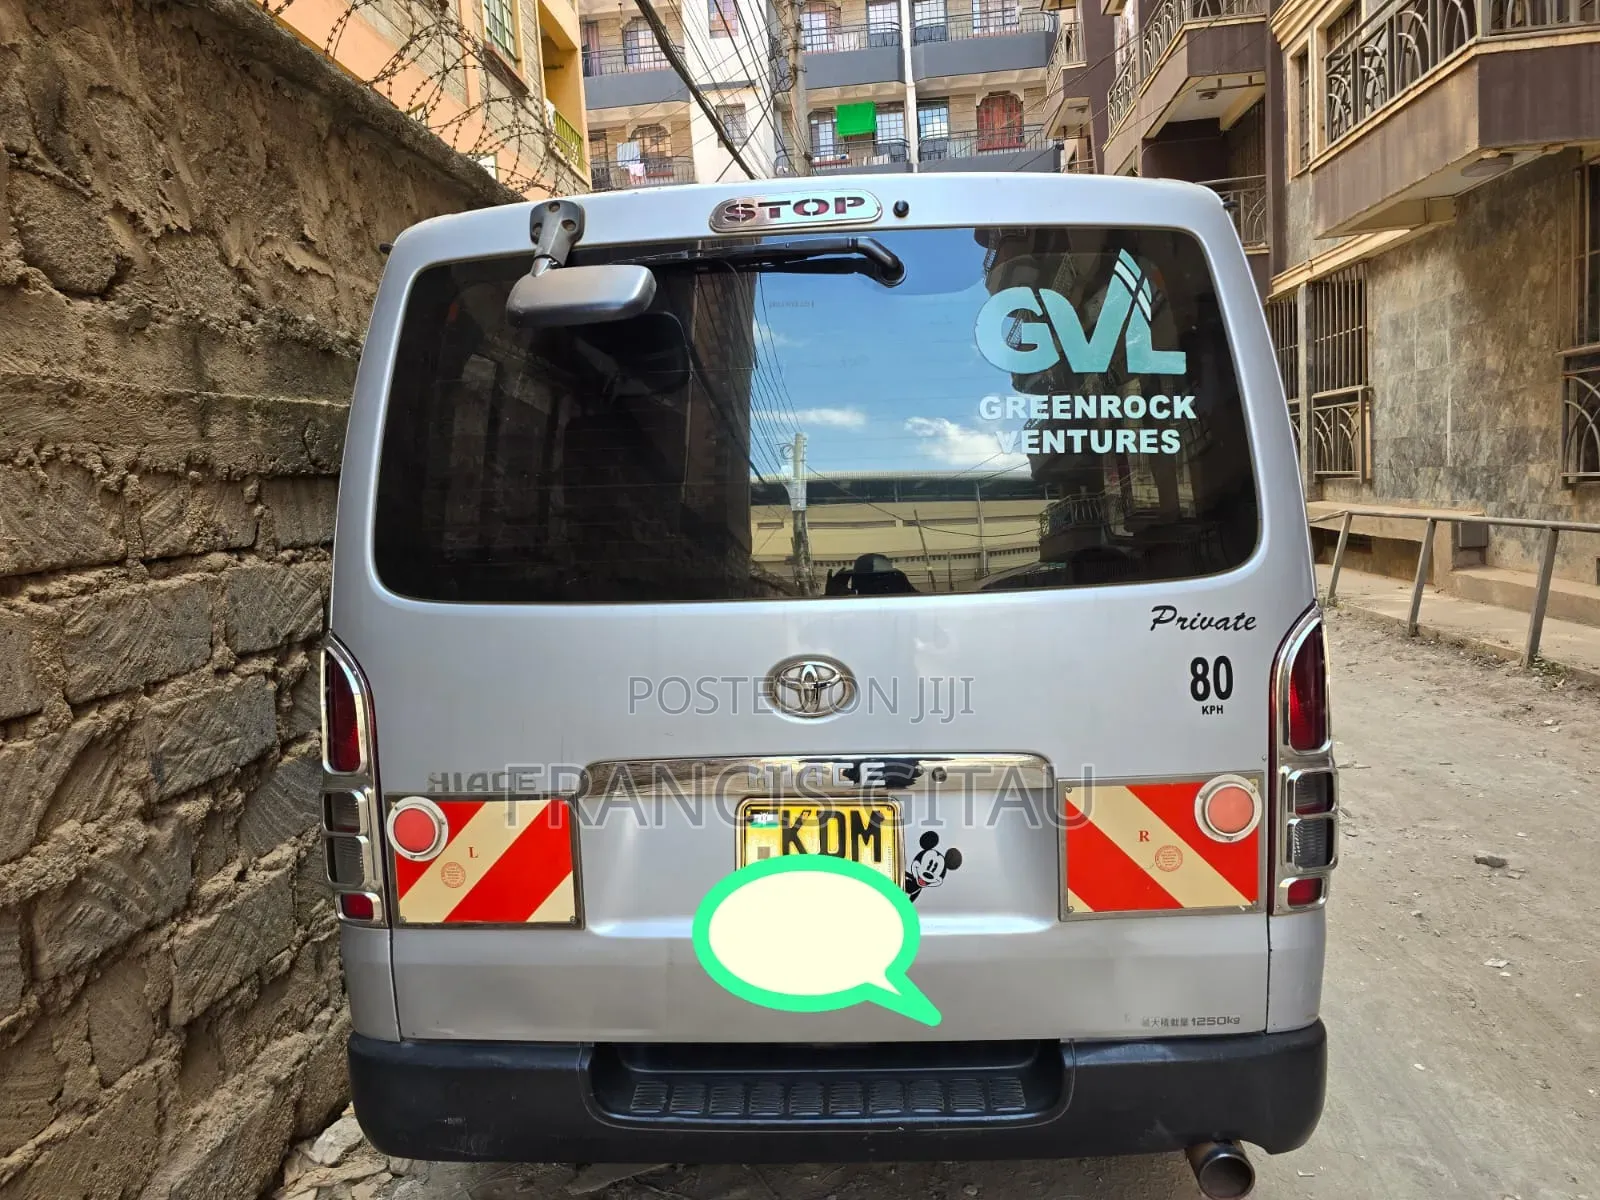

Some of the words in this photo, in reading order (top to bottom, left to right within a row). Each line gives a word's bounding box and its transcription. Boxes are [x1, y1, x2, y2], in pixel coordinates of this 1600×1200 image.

[724, 196, 865, 222] STOP
[974, 248, 1187, 375] GVL
[979, 395, 1197, 420] GREENROCK
[995, 429, 1181, 455] VENTURES
[1150, 605, 1257, 631] Private
[1190, 655, 1234, 702] 80
[1202, 705, 1224, 715] KPH
[427, 771, 537, 793] HIACE
[748, 762, 886, 788] HIACE
[1139, 830, 1150, 842] R
[468, 846, 479, 859] L
[1191, 1015, 1241, 1027] 1250kg
